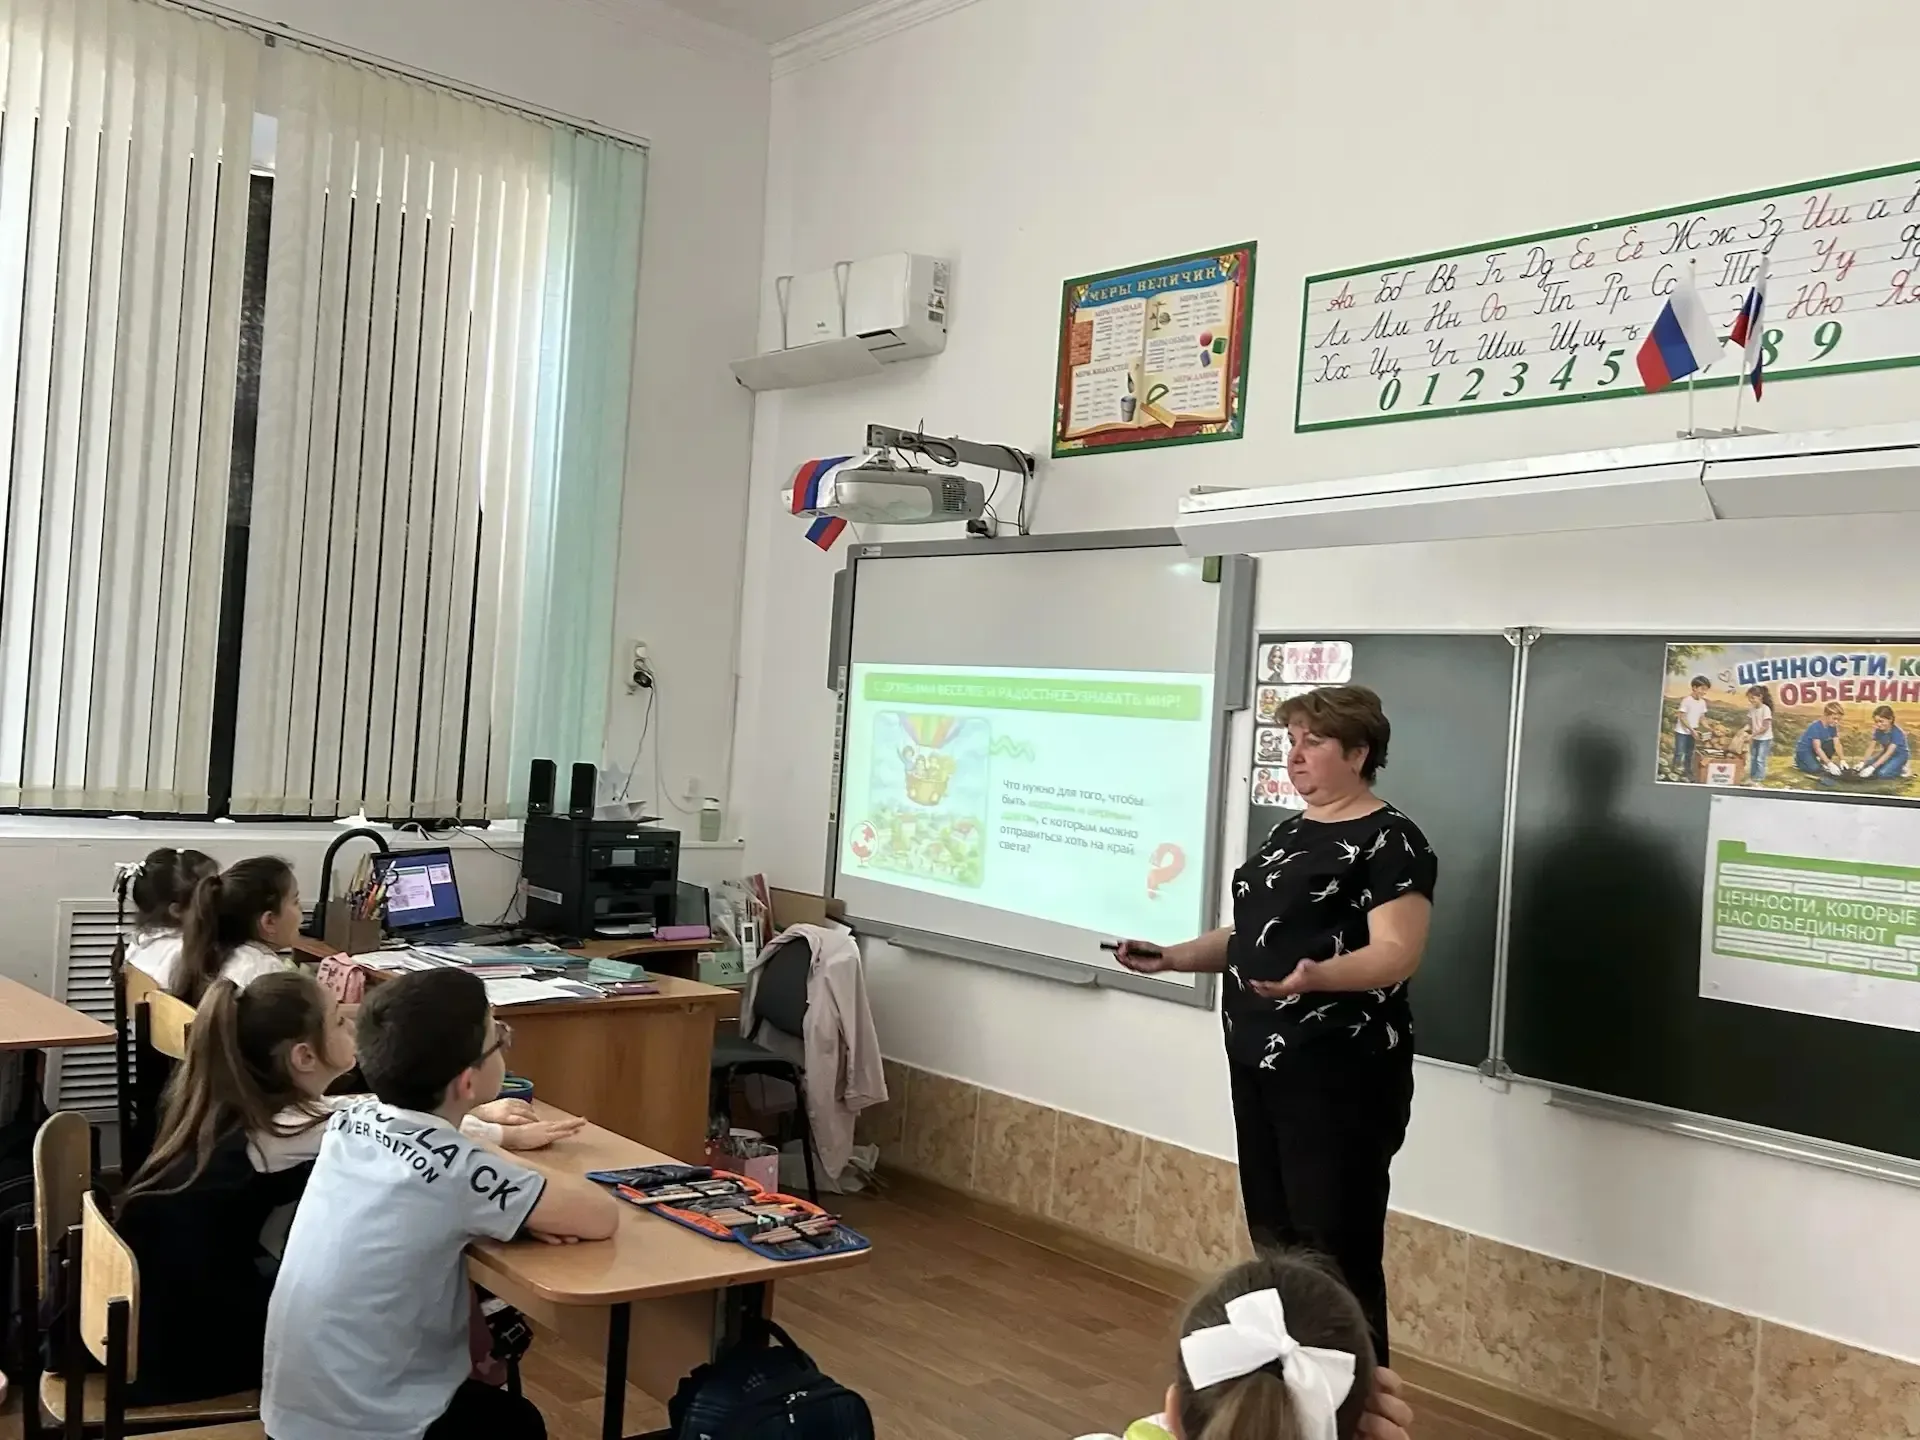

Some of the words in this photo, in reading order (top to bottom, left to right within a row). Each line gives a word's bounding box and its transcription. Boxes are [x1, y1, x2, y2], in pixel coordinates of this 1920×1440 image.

[1089, 284, 1132, 301] МЕРЫ
[1137, 267, 1216, 292] ВЕЛИЧИН
[1379, 378, 1401, 411] 0
[1417, 372, 1440, 406] 1
[1458, 367, 1485, 402] 2
[1502, 361, 1528, 396] 3
[1549, 354, 1577, 391] 4
[1597, 349, 1625, 386] 5
[1761, 328, 1784, 367] 8
[1808, 320, 1842, 362] 9
[1737, 654, 1894, 685] ЦЕННОСТИ,
[1780, 680, 1920, 706] ОБЪЕДИН
[1003, 779, 1020, 790] Что
[1022, 783, 1055, 794] нужно
[1108, 794, 1144, 806] чтобы
[1717, 889, 1821, 917] ЦЕННОСТИ,
[1826, 901, 1917, 926] КОТОРЫЕ
[1717, 909, 1753, 926] НАС
[1757, 912, 1888, 944] ОБЪЕДИНЯЮТ
[375, 1129, 440, 1184] EDITION
